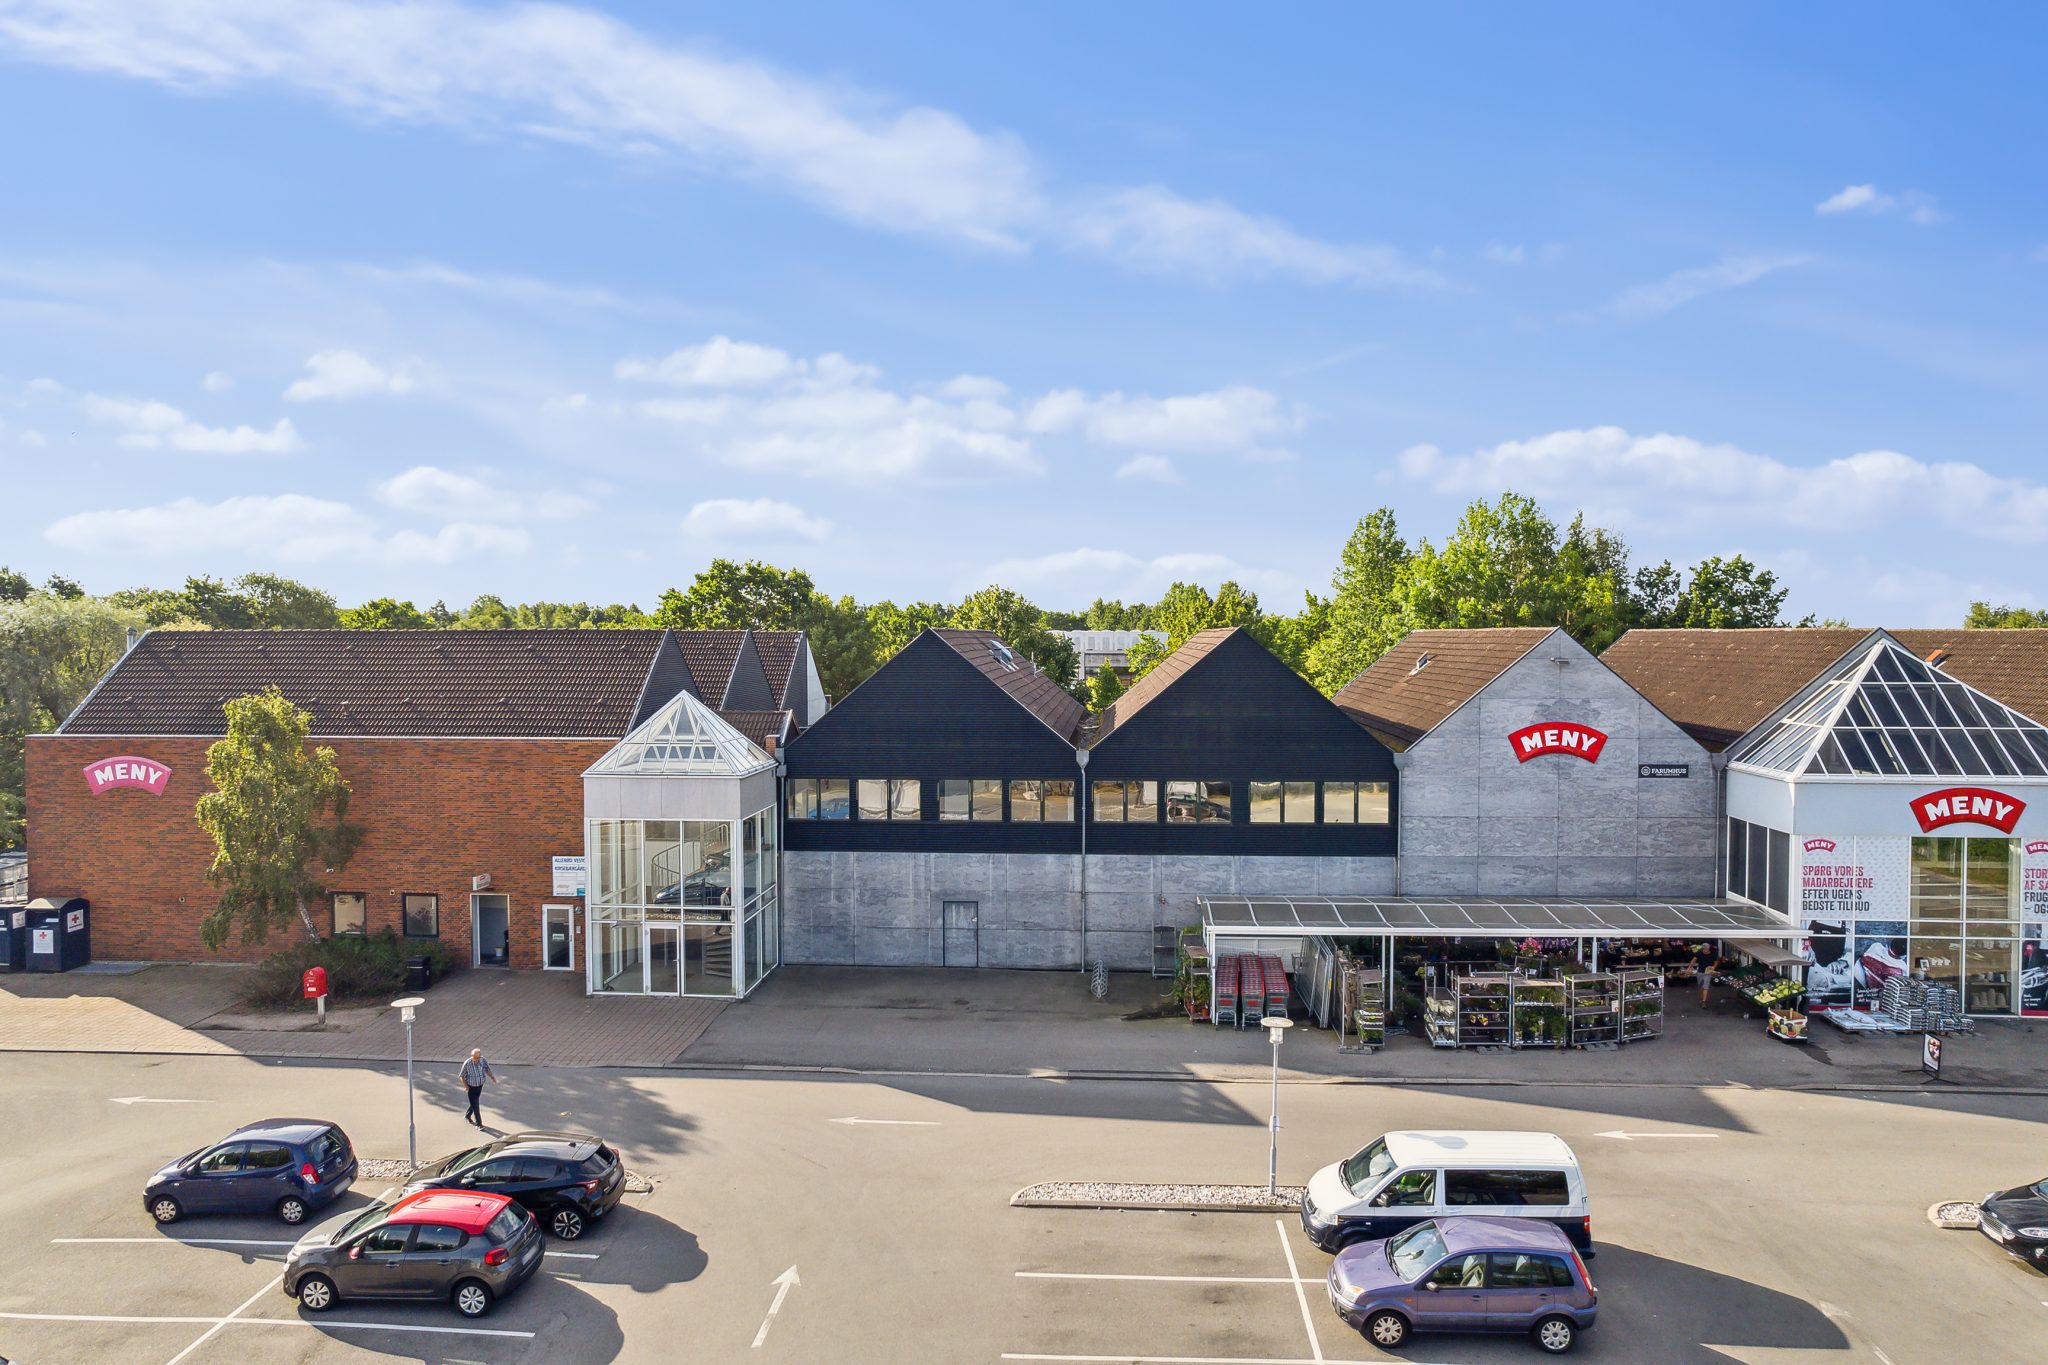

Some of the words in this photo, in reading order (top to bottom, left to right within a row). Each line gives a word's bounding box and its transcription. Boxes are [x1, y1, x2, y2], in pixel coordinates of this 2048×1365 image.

[1520, 729, 1598, 753] MENY
[93, 763, 163, 785] MENY
[1924, 795, 2014, 822] MENY
[1806, 840, 1833, 849] MENY
[1802, 865, 1832, 876] SPØRG
[1834, 865, 1864, 877] VORES
[2024, 880, 2036, 891] AF
[1802, 888, 1829, 899] EFTER
[1831, 889, 1863, 900] UGENS
[2024, 891, 2048, 903] FRUG
[1802, 900, 1835, 911] BEDSTE
[1837, 900, 1870, 911] TILBUD
